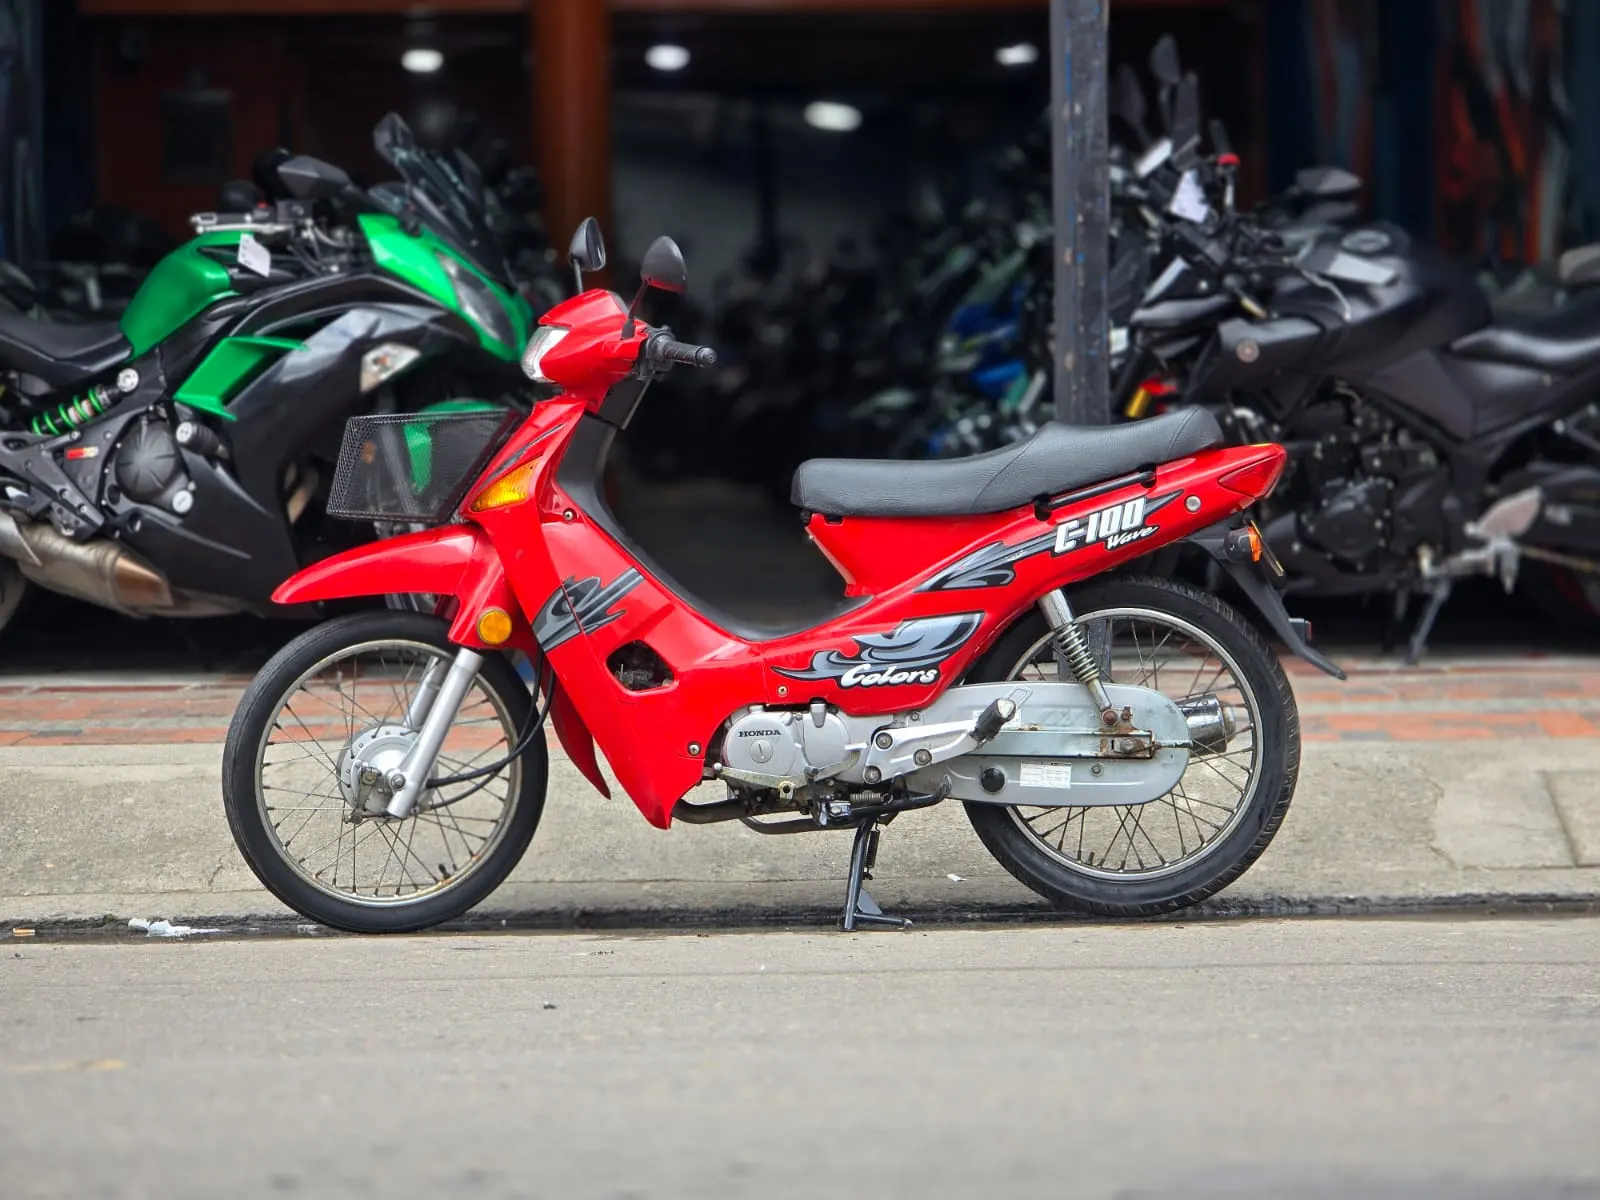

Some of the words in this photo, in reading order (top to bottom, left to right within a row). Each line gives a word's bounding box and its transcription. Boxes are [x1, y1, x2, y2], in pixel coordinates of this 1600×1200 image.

[1054, 496, 1147, 553] C-100
[1107, 525, 1159, 550] Wave
[840, 663, 938, 688] Colors
[738, 729, 782, 738] HONDA
